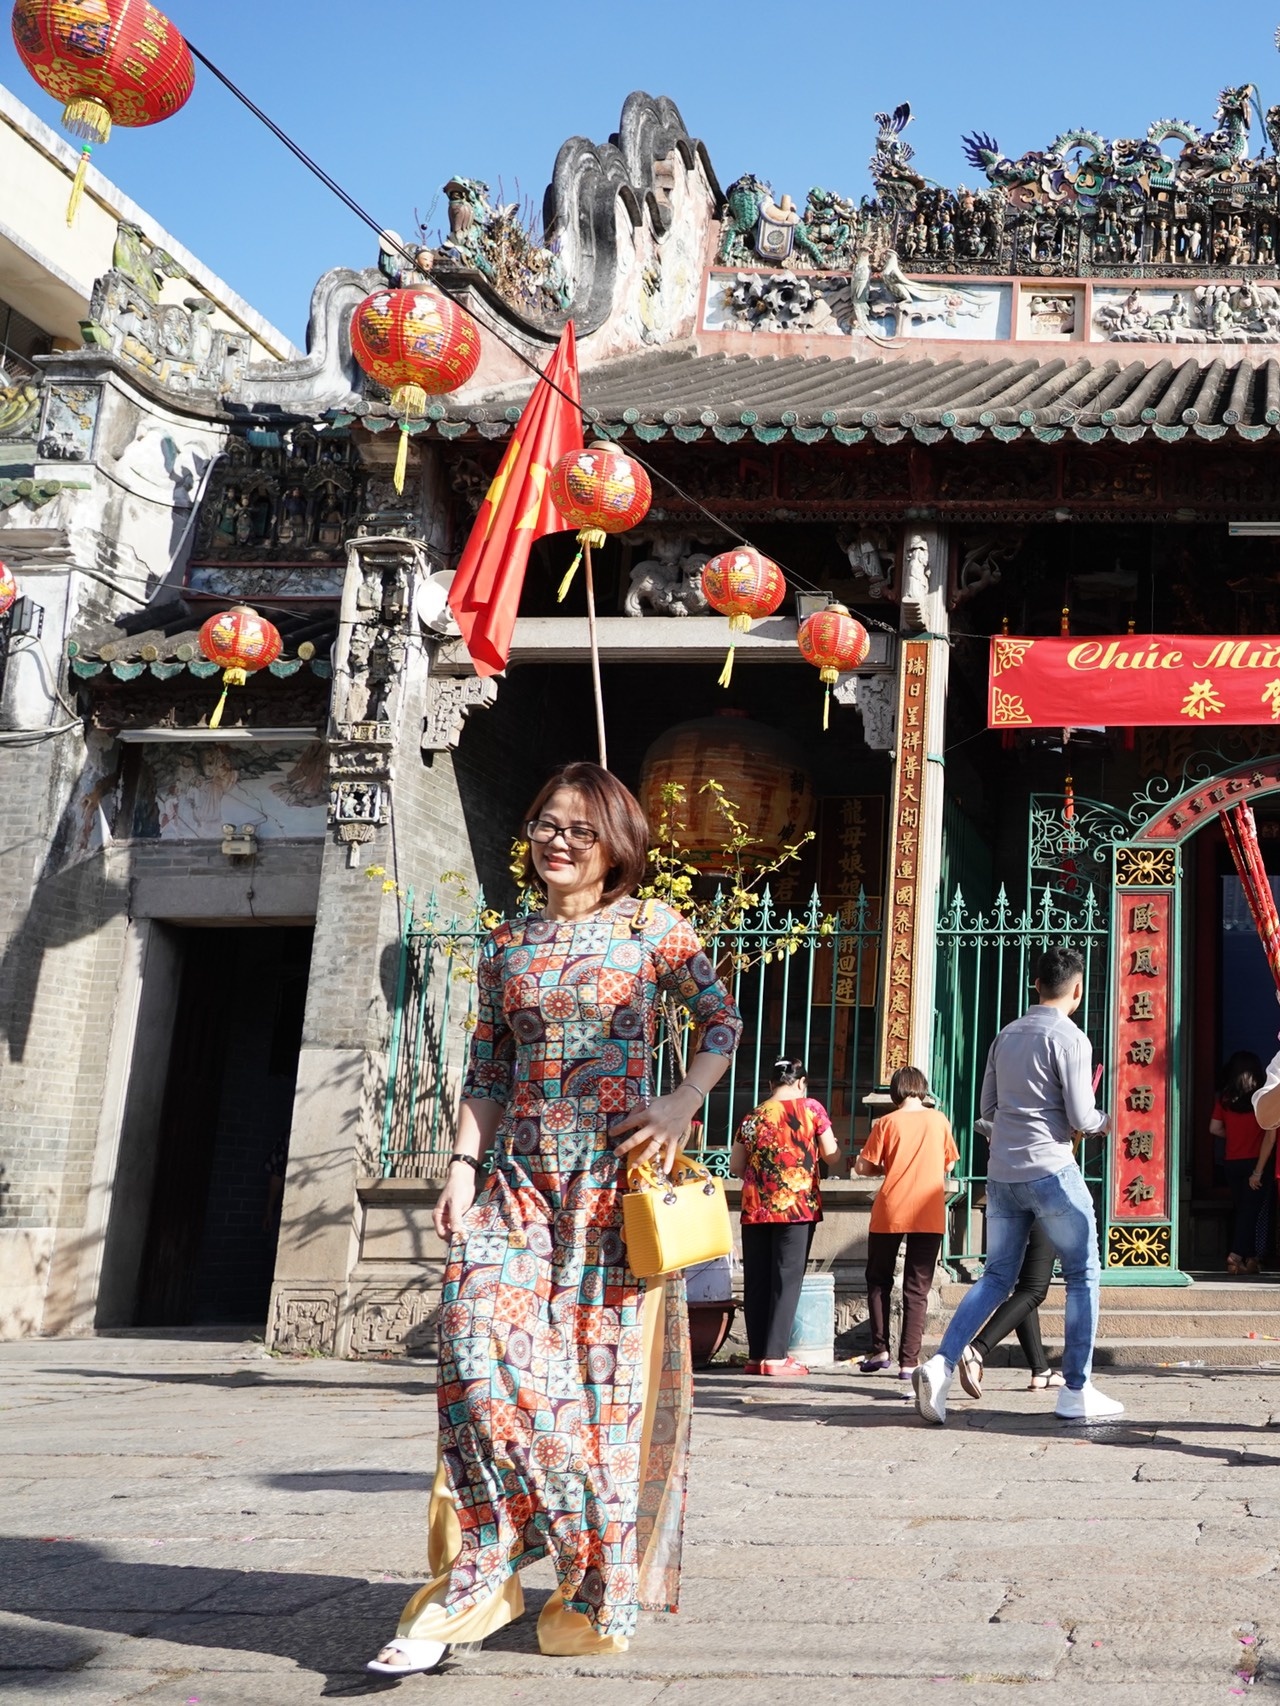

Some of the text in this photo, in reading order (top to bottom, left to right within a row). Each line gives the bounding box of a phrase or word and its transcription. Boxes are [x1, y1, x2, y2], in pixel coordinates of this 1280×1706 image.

[1067, 640, 1183, 669] Chúc
[1128, 902, 1160, 1205] 歐風亞雨兩調和
